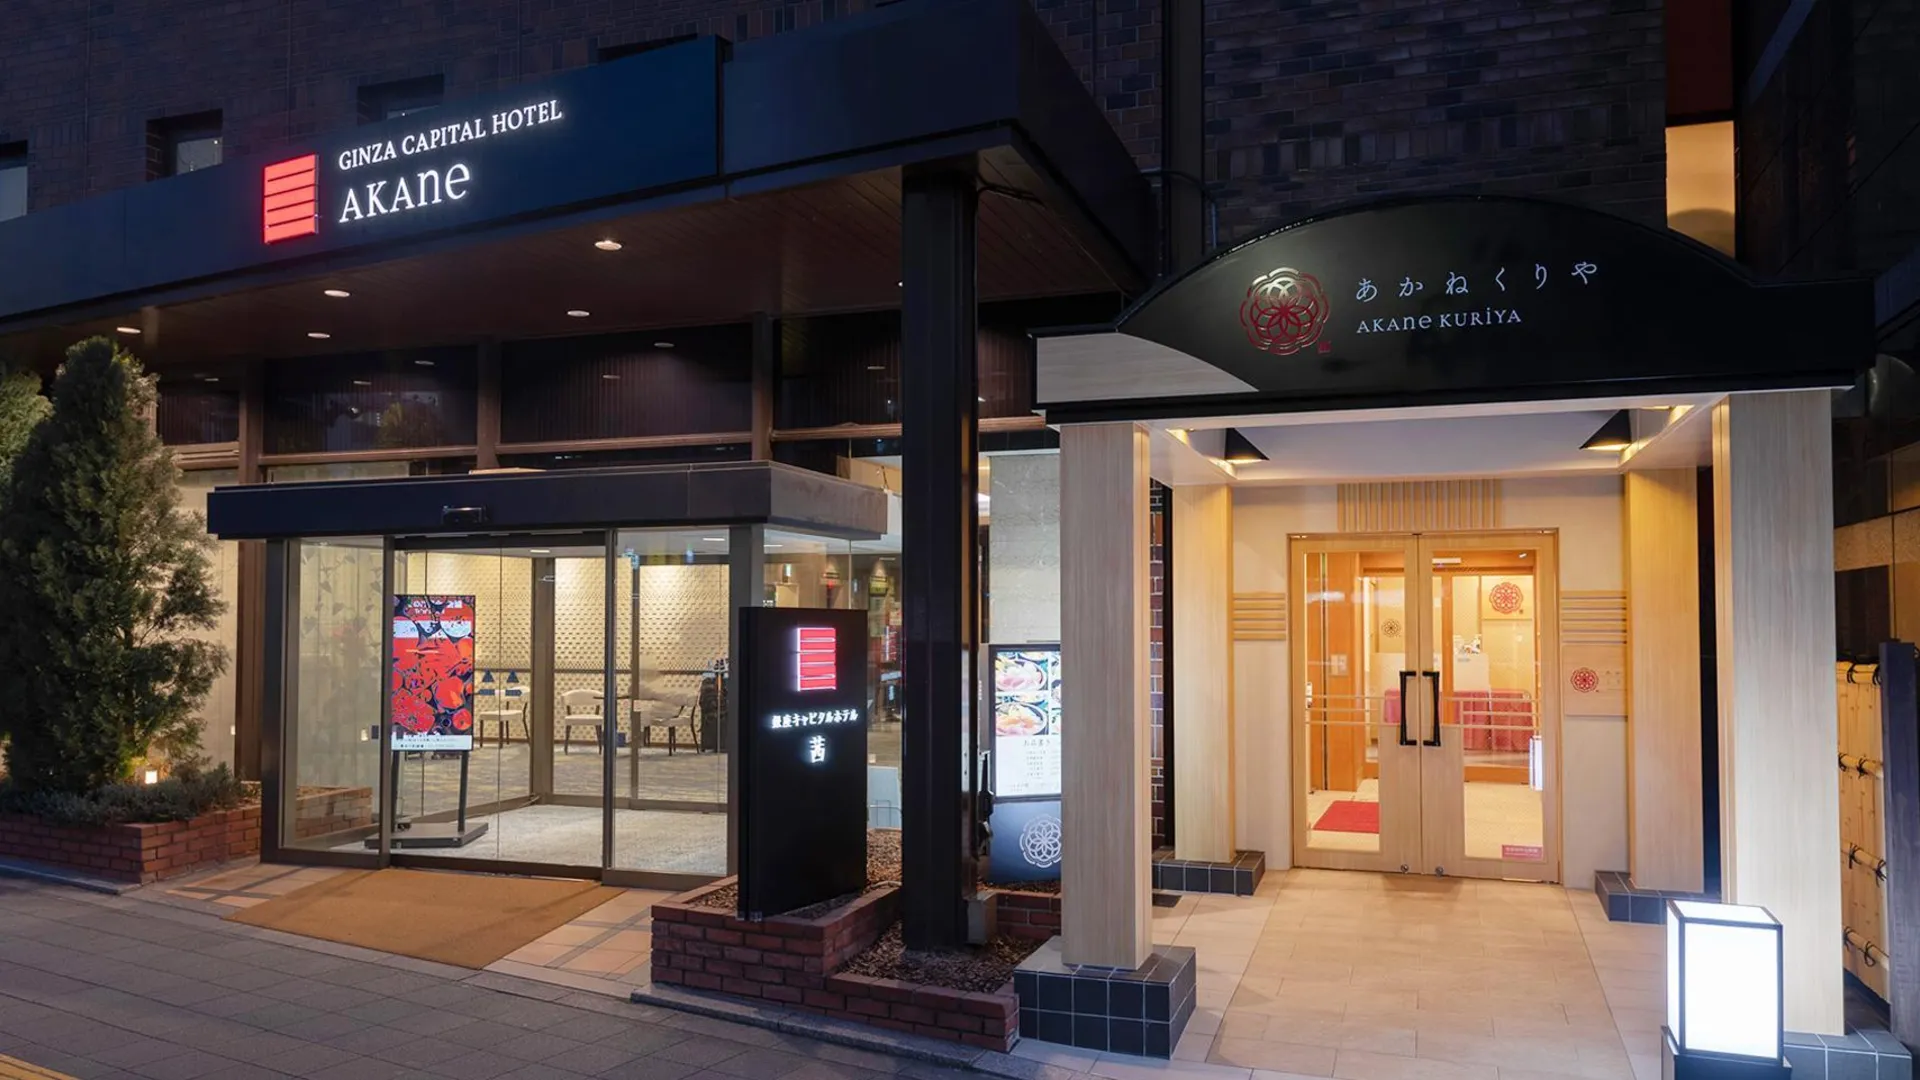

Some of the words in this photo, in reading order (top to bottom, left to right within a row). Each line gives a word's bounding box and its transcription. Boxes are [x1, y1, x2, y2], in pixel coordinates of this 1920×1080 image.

[339, 141, 397, 171] GINZA
[401, 118, 487, 155] CAPITAL
[491, 100, 563, 135] HOTEL
[1355, 261, 1598, 303] あかねくりや
